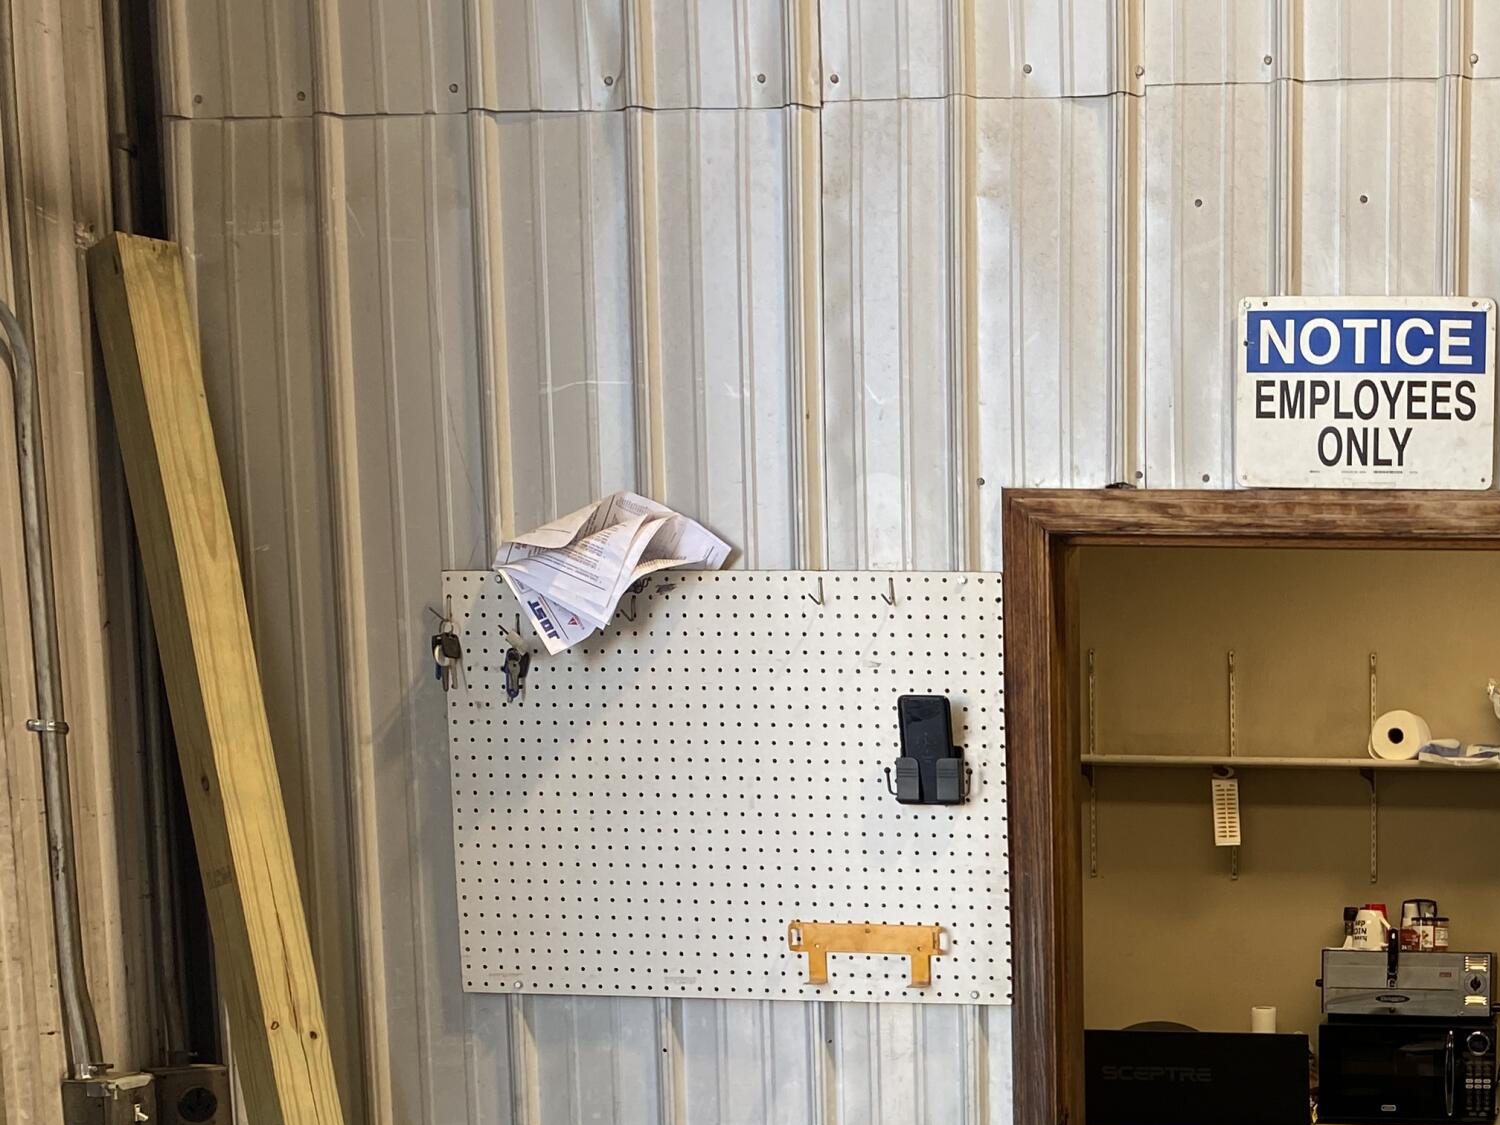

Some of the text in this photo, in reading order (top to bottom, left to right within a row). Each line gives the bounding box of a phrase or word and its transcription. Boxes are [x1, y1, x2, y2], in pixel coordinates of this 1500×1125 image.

[1259, 318, 1473, 366] NOTICE
[1255, 379, 1476, 422] EMPLOYEES
[1317, 425, 1413, 467] ONLY
[527, 600, 561, 639] JOST
[1102, 1065, 1214, 1082] SCEPTRE
